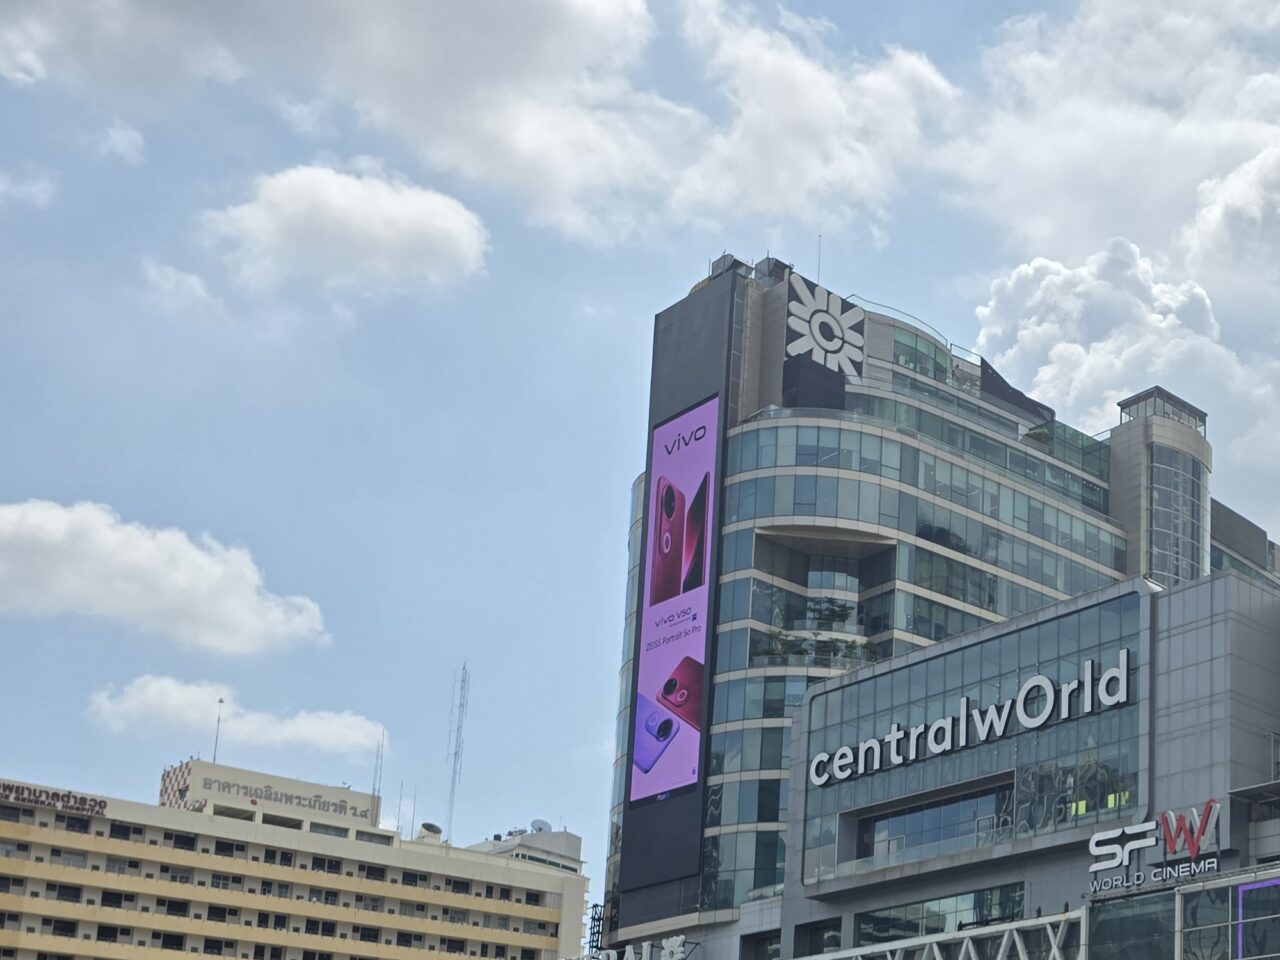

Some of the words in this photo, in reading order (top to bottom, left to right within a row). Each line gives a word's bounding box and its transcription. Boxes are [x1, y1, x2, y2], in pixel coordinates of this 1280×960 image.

[664, 425, 706, 455] vivo
[655, 614, 675, 627] vivo
[0, 782, 107, 810] พยาบาลตำรวจ
[1089, 871, 1146, 893] WORLD
[1151, 858, 1218, 882] CINEMA
